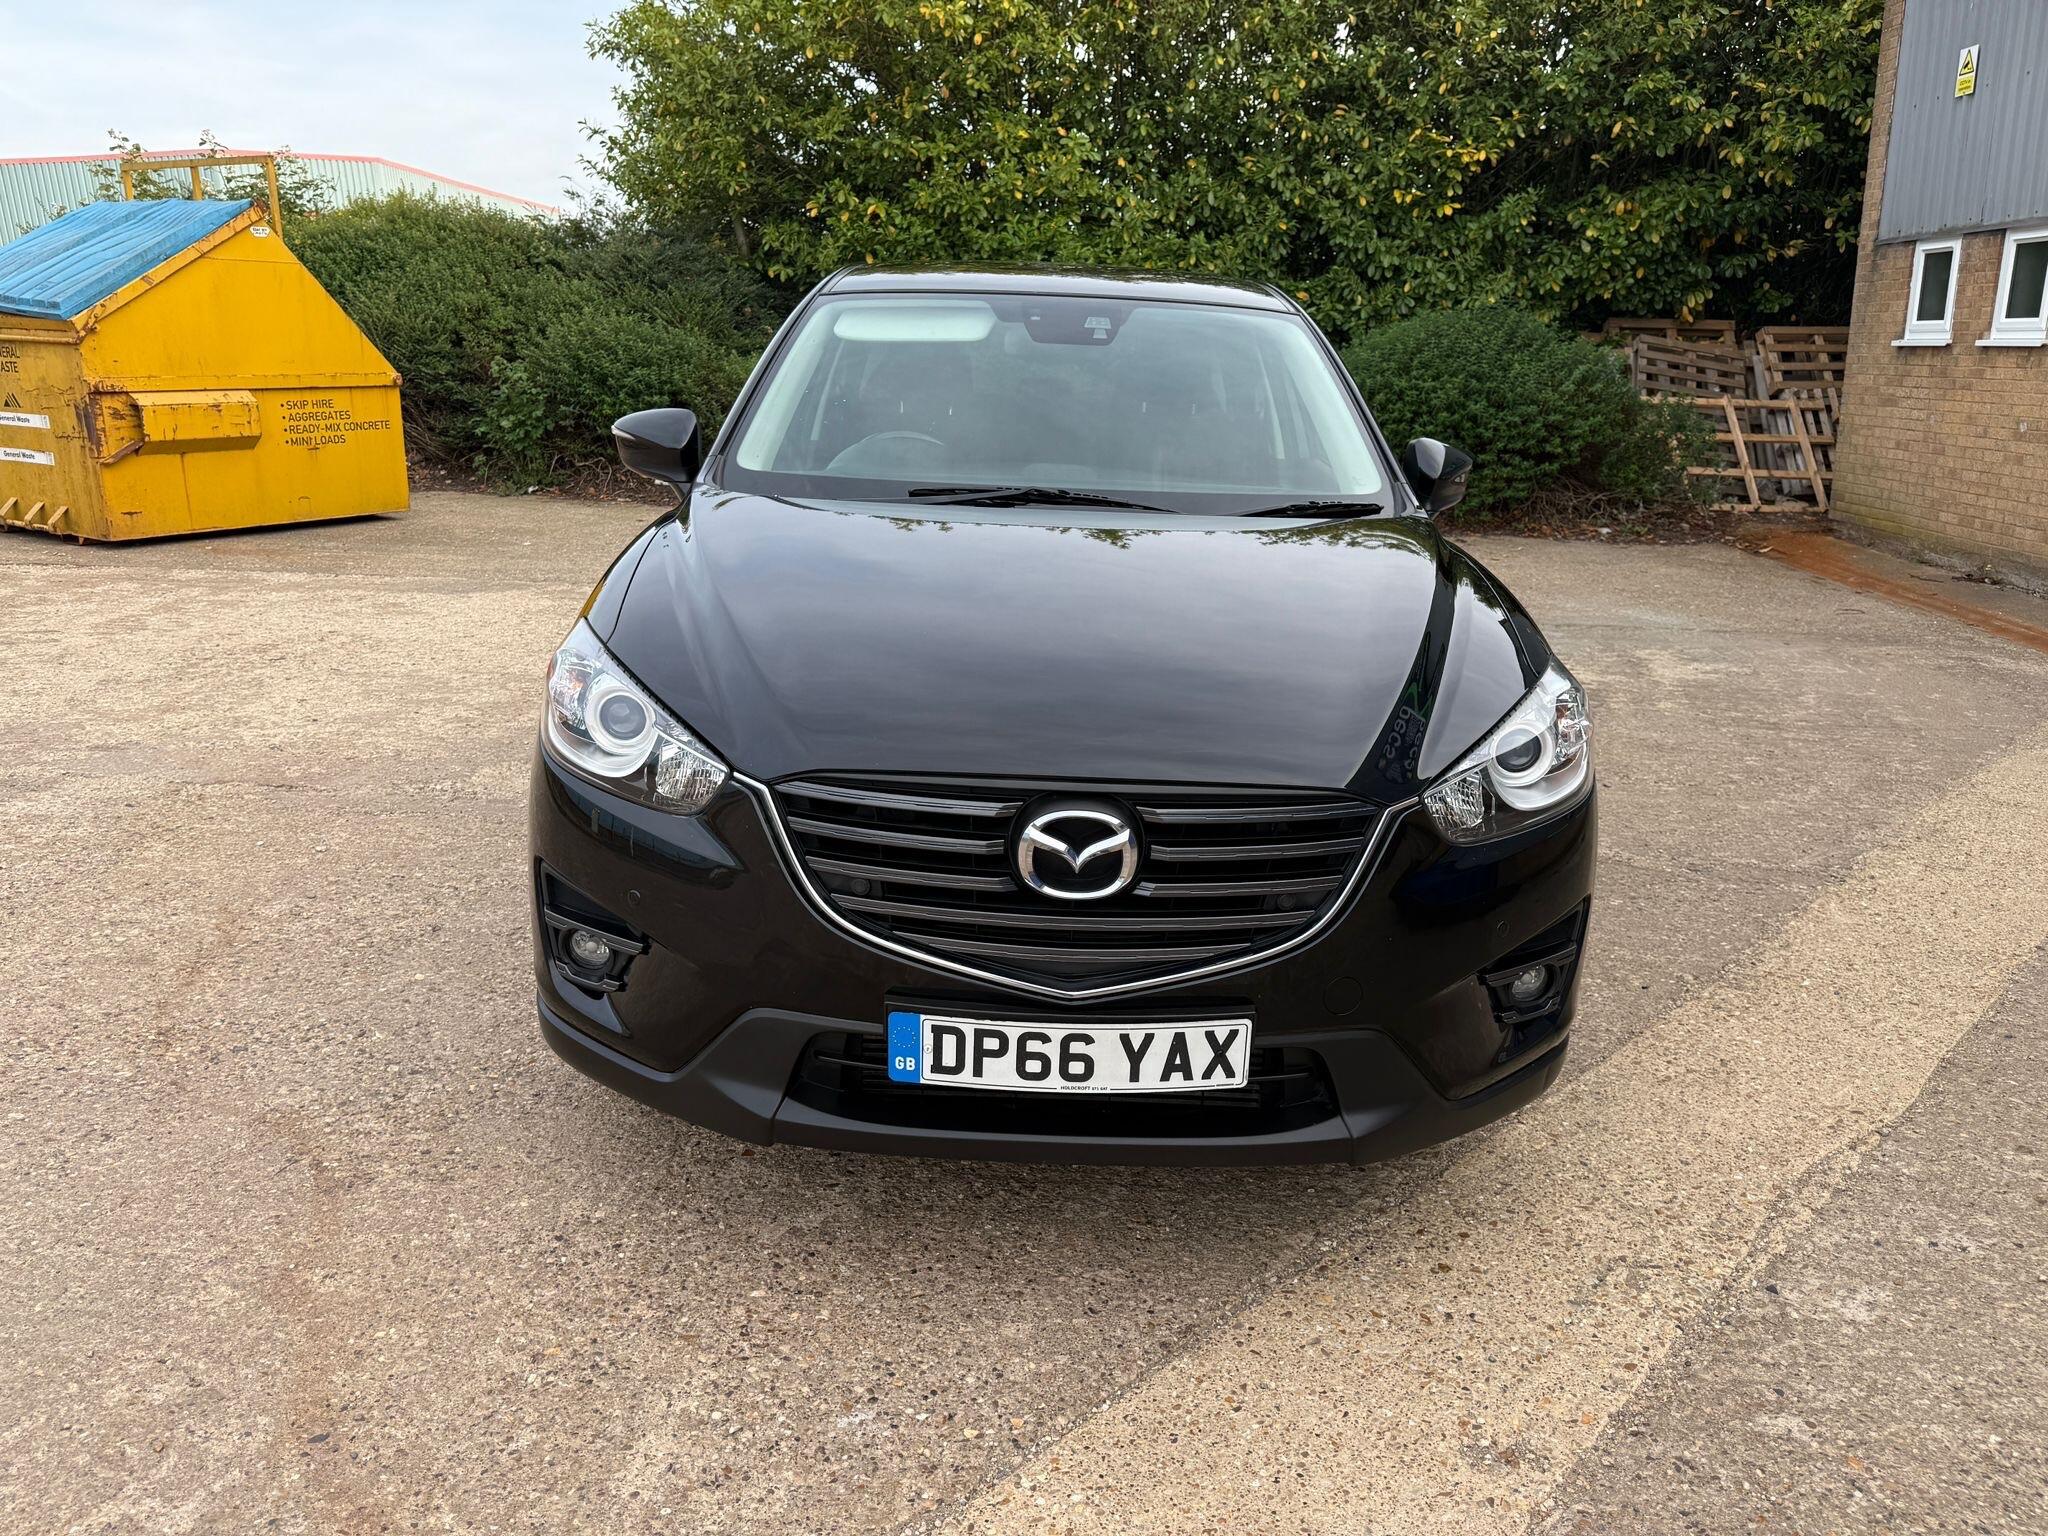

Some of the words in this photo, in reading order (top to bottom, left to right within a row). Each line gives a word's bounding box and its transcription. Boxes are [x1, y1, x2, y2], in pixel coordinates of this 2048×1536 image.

[286, 400, 309, 410] SKIP
[312, 399, 334, 409] HIRE
[288, 410, 351, 422] AGGREGATES
[289, 423, 341, 434] READY-MIX
[343, 420, 391, 432] CONCRETE
[290, 437, 312, 447] MINI
[314, 434, 346, 446] LOADS
[21, 451, 35, 459] Waste
[930, 1024, 1096, 1083] DP66
[1119, 1029, 1240, 1083] YAX
[895, 1056, 915, 1070] GB
